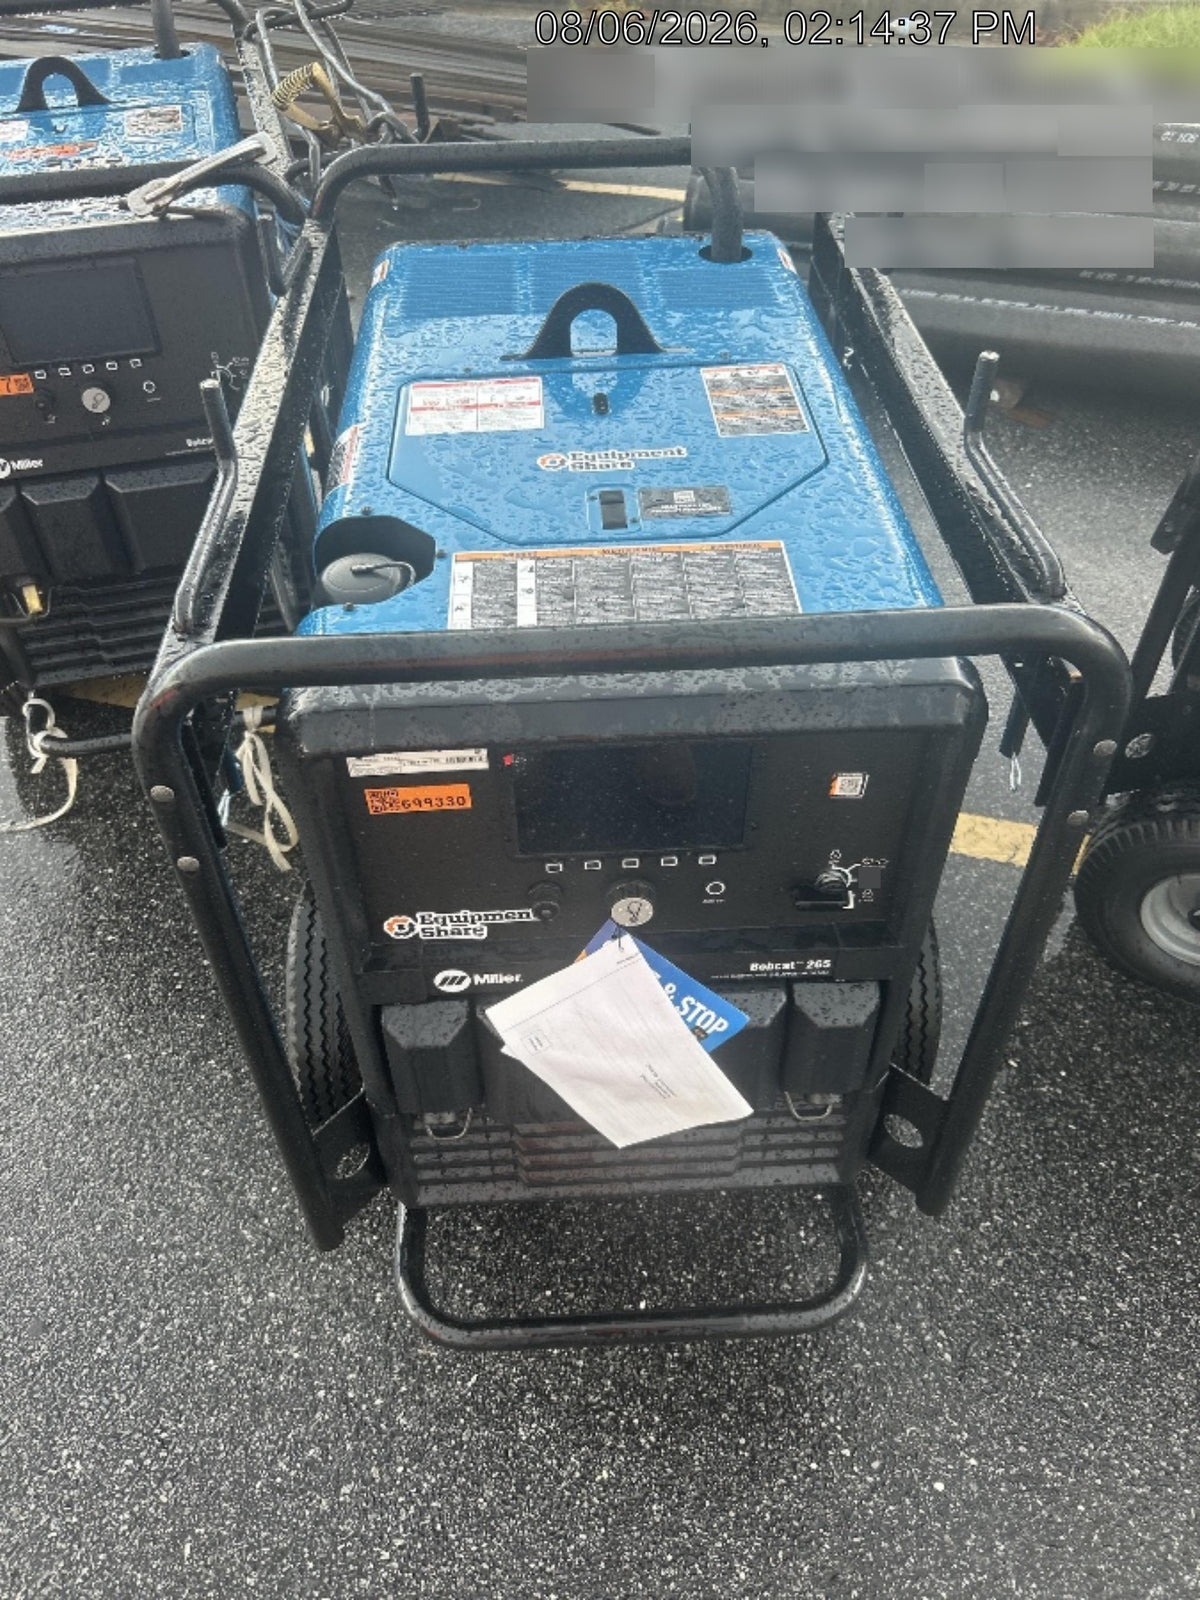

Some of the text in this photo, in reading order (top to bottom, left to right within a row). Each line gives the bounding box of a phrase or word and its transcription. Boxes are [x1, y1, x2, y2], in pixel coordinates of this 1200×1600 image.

[570, 448, 686, 462] Equipment
[400, 795, 467, 809] 699330
[420, 924, 486, 938] Share
[805, 959, 831, 969] 265
[473, 973, 521, 986] Miller
[679, 995, 729, 1035] STOP
